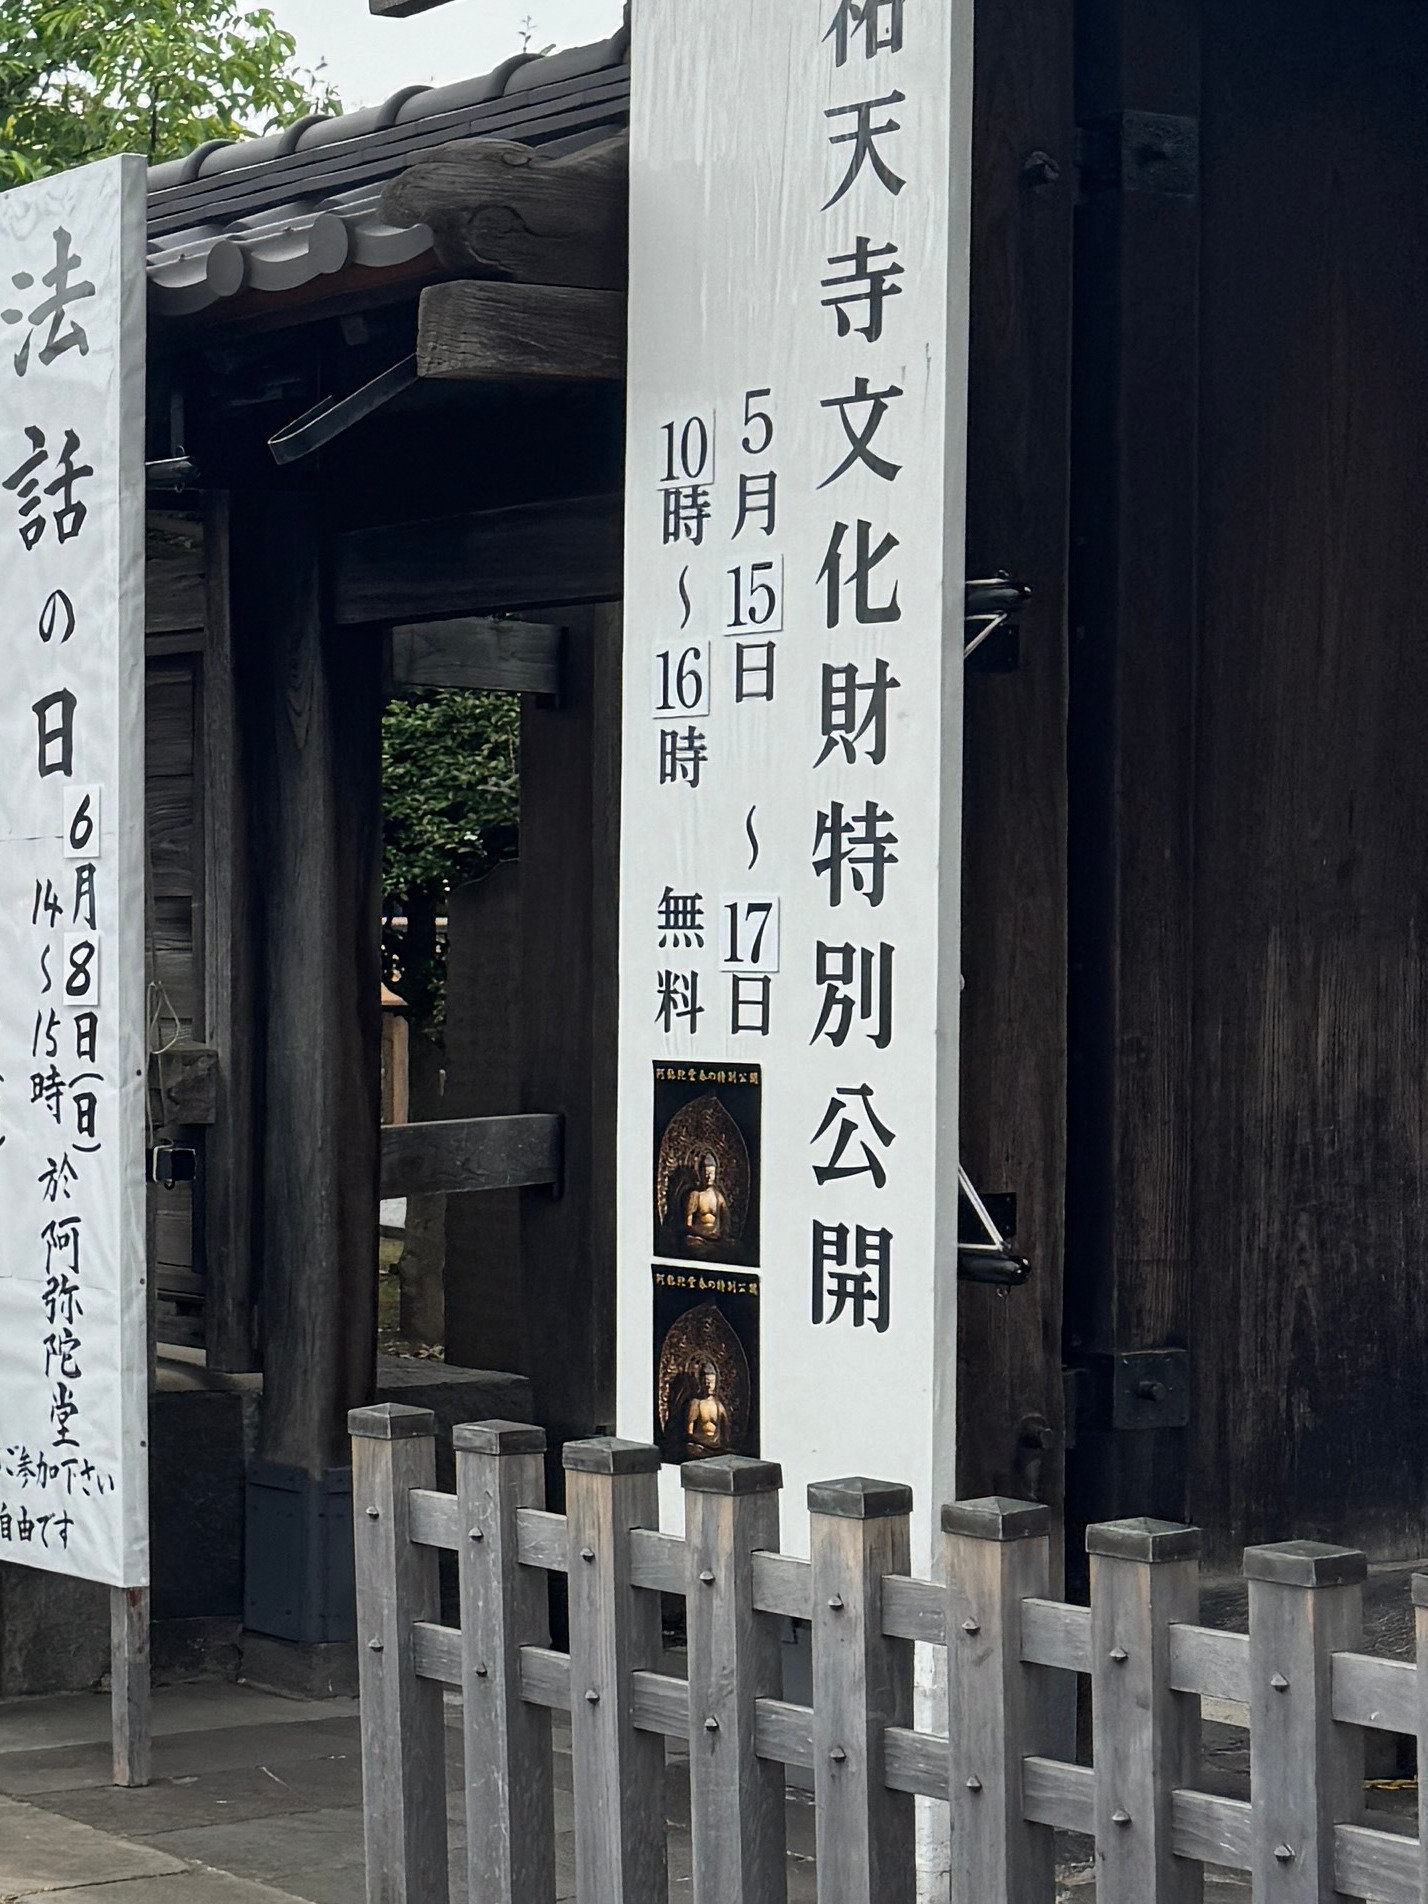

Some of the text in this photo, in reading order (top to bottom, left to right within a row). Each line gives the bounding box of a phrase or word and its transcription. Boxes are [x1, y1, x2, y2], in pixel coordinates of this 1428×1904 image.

[0, 225, 96, 781] 法話の日
[654, 885, 705, 1035] 無料
